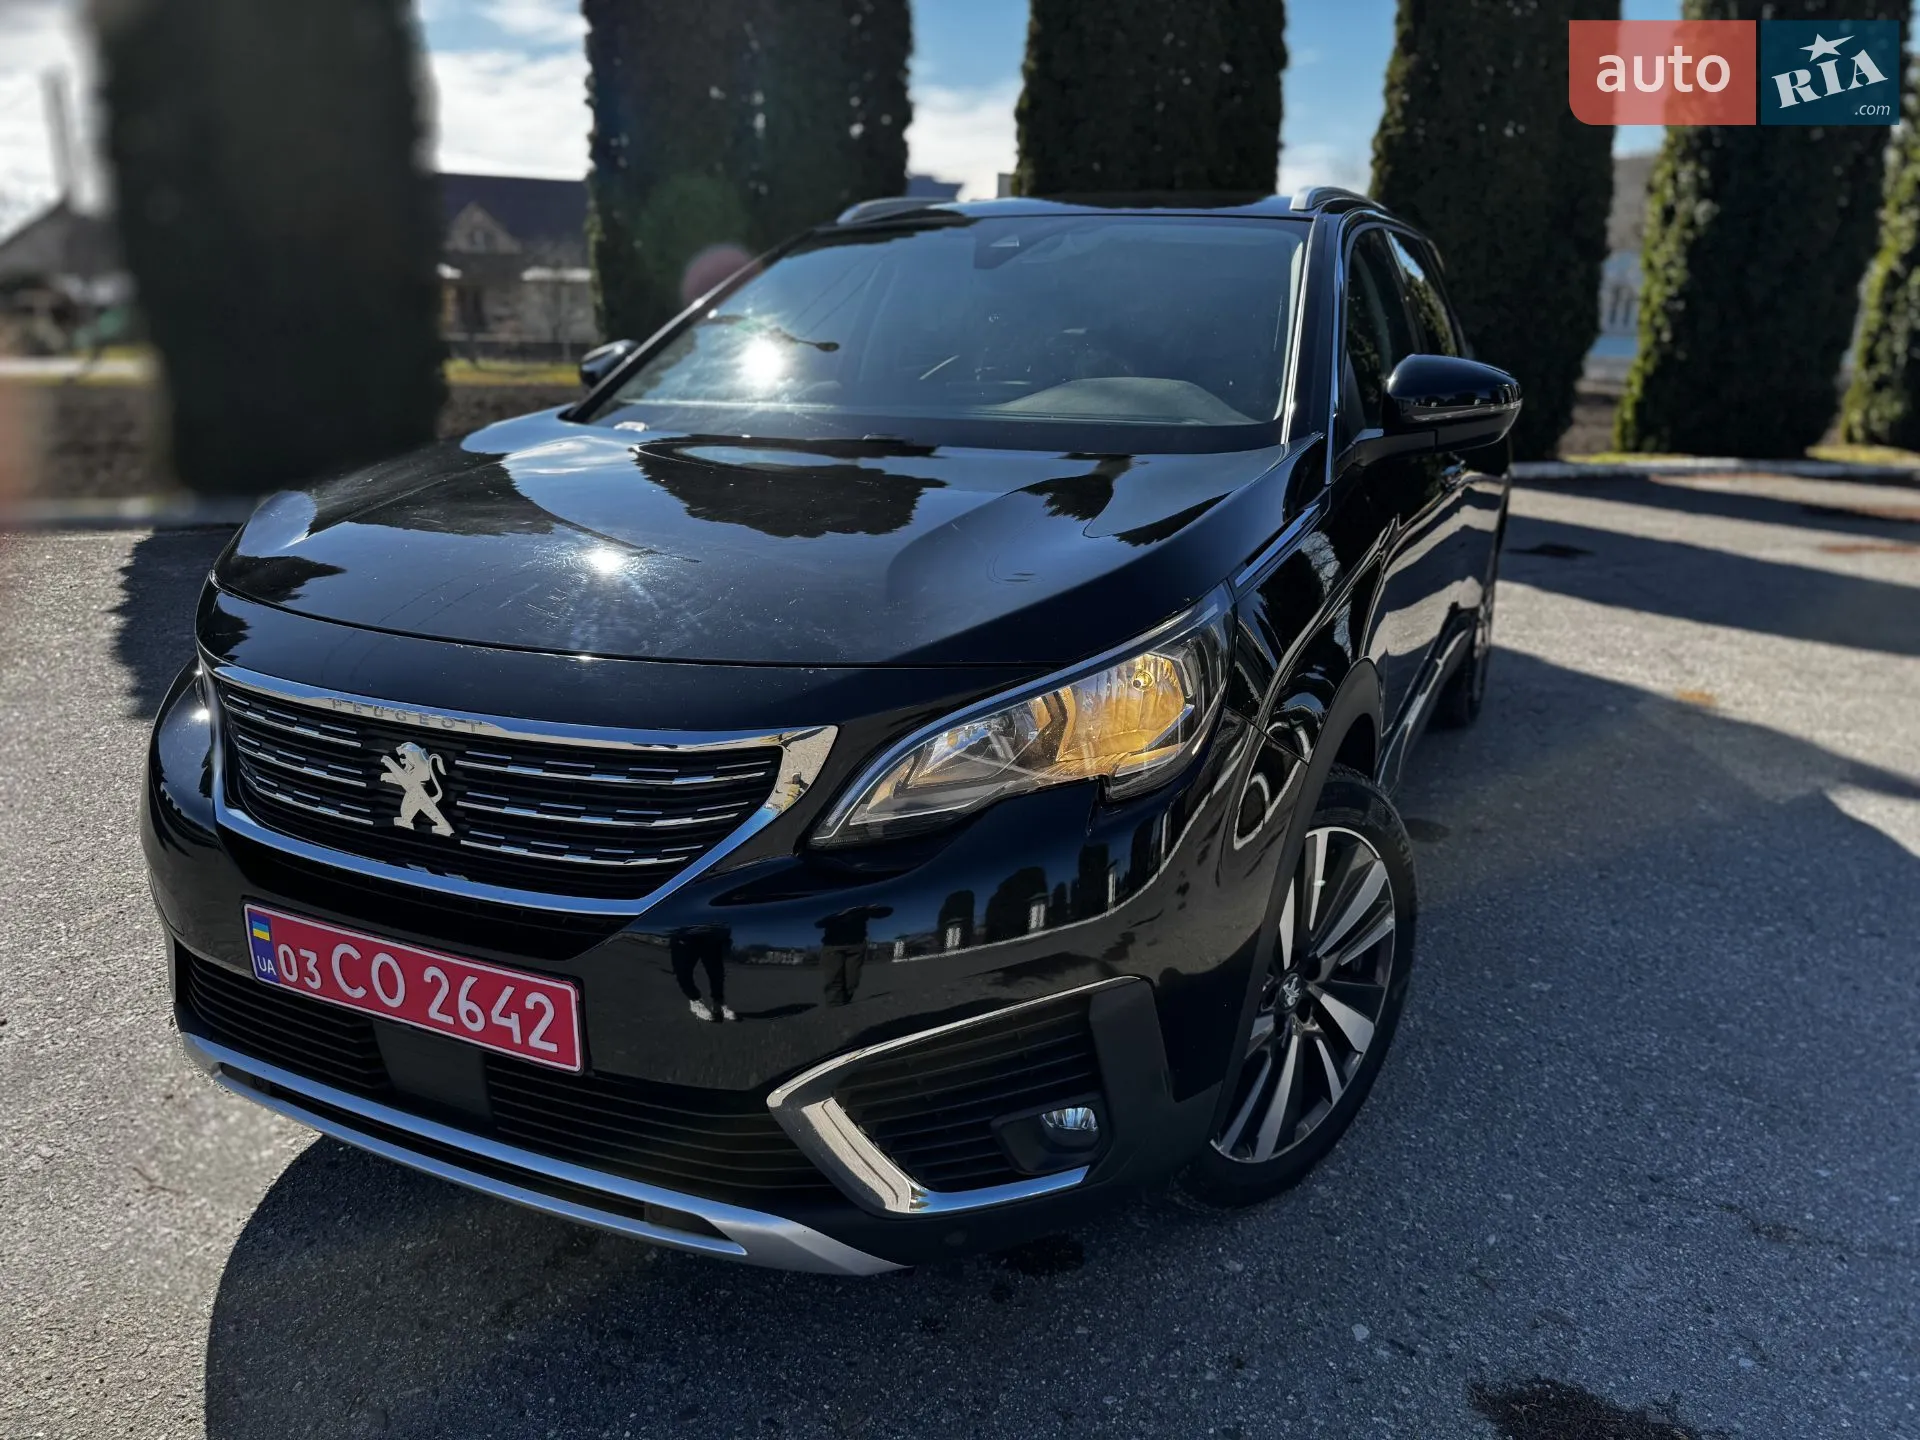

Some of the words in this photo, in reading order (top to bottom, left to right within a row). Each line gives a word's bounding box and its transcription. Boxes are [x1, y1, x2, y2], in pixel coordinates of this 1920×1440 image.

[331, 698, 483, 733] PEUGEOT
[257, 955, 277, 977] UA
[277, 943, 322, 990] 03
[331, 943, 406, 1008] CO
[423, 966, 558, 1053] 2642
